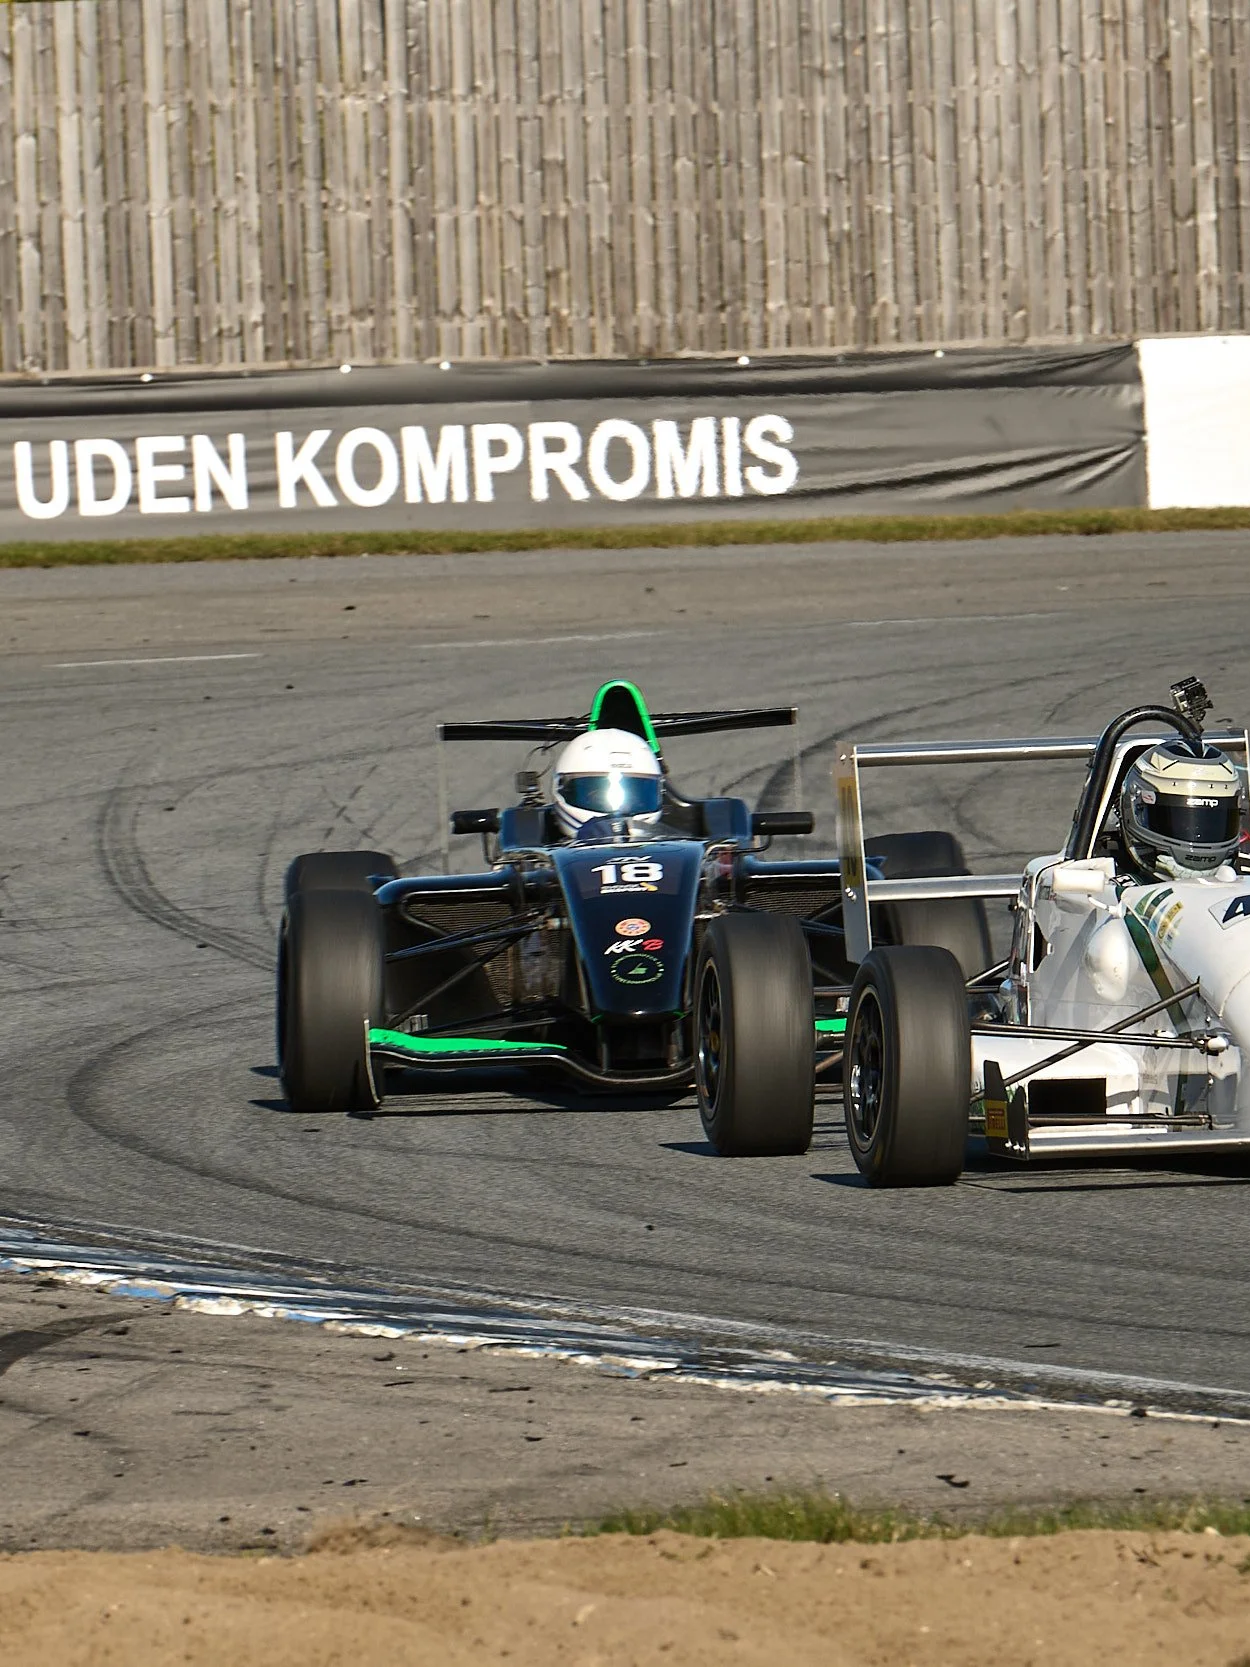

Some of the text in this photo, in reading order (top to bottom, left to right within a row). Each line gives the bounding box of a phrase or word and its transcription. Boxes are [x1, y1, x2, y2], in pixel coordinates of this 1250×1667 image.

[13, 415, 800, 519] UDEN KOMPROMIS
[1186, 798, 1219, 808] zamp
[591, 863, 664, 885] 18
